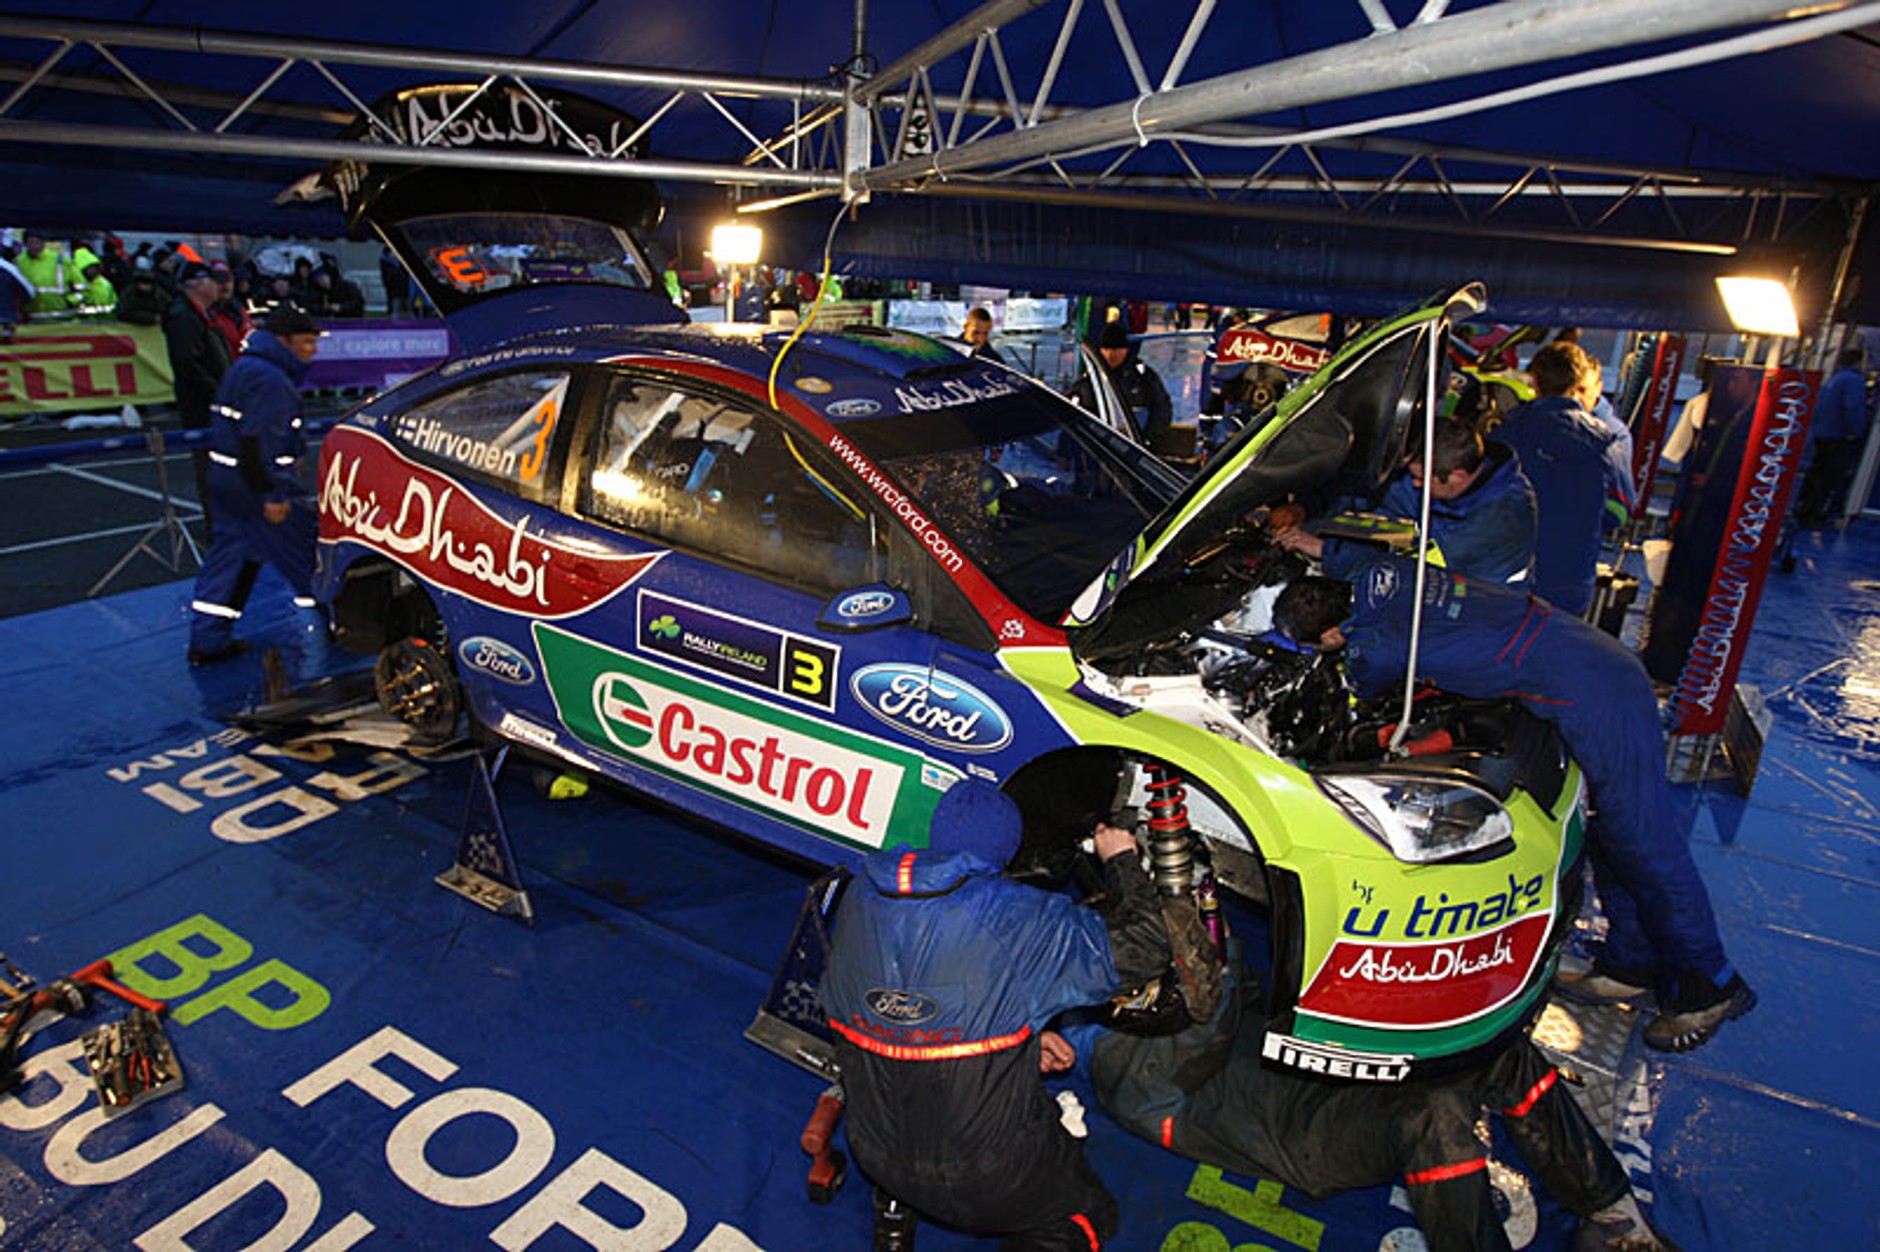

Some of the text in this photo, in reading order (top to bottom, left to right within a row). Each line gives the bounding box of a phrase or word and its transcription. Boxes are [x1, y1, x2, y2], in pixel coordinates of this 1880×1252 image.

[413, 399, 557, 480] Hirvonen 3
[829, 434, 964, 572] www.wrcford.com
[791, 650, 824, 695] 3
[658, 702, 873, 831] Castrol
[102, 914, 331, 1030] BP
[851, 1013, 965, 1043] RACING
[1262, 1031, 1415, 1081] PIRELLI
